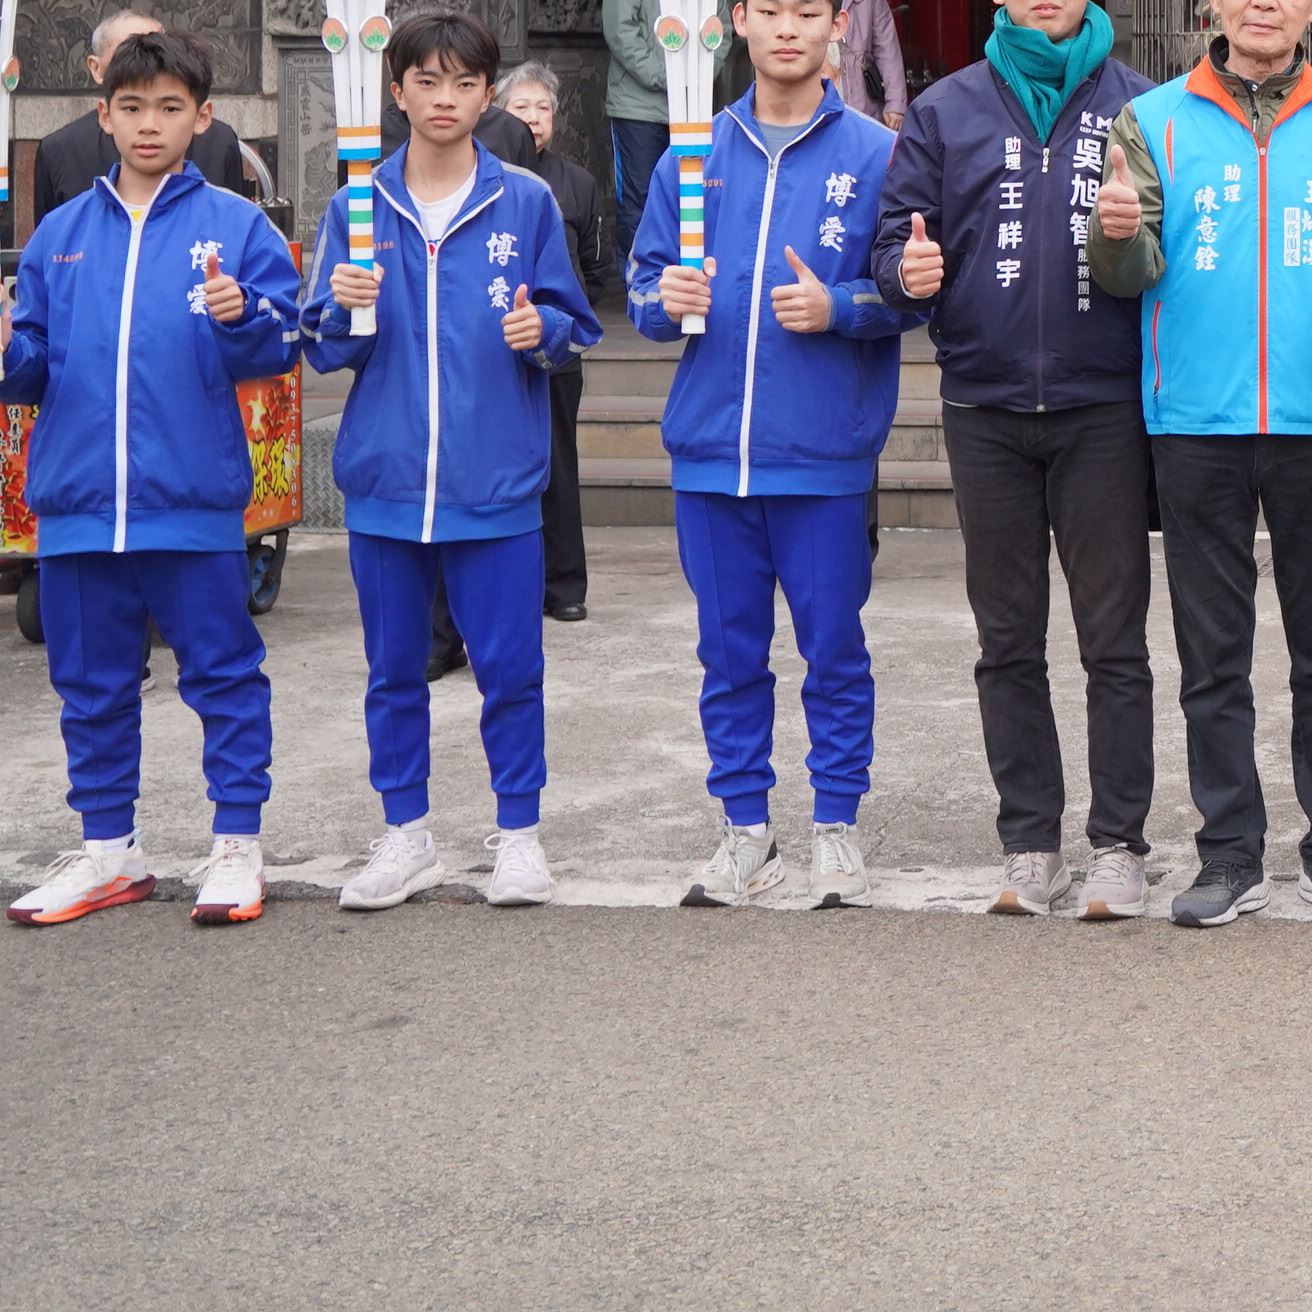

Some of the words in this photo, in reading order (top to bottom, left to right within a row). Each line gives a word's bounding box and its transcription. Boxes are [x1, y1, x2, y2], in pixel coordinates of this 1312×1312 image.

[1004, 136, 1022, 170] 助理
[1224, 164, 1242, 203] 助理
[818, 171, 857, 252] 博愛
[996, 181, 1024, 288] 王祥宇
[485, 231, 519, 312] 博愛
